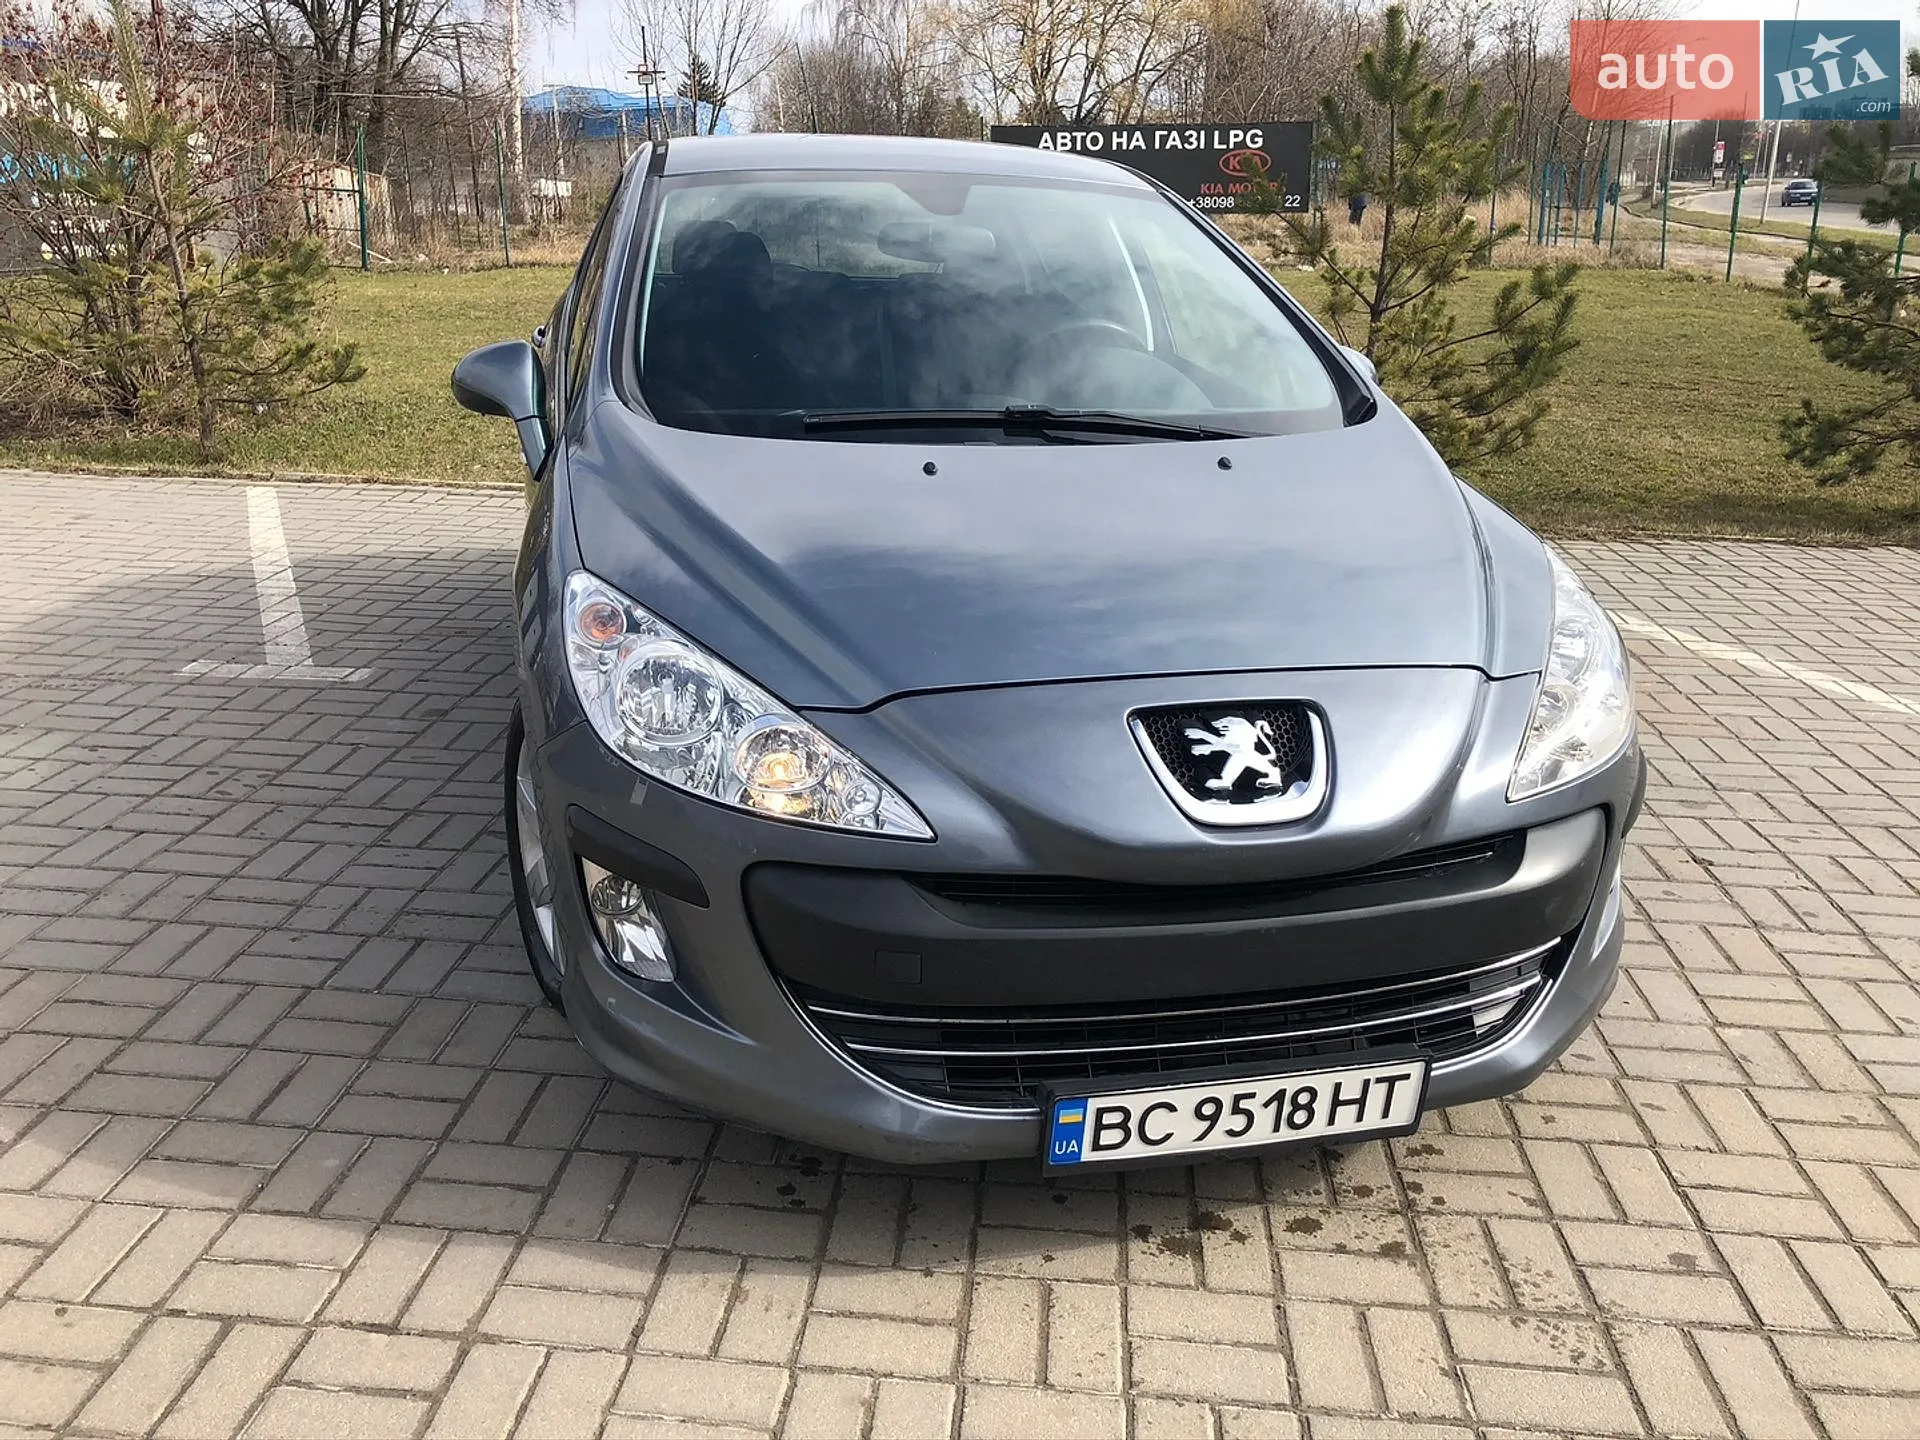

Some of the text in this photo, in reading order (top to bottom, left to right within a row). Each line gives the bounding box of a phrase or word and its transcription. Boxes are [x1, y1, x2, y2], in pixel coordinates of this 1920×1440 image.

[1038, 129, 1263, 151] АВТО НА ГАЗІ LPG
[1200, 183, 1225, 195] KIA
[1091, 1072, 1411, 1153] BC 9518 HT
[1054, 1140, 1079, 1155] UA
